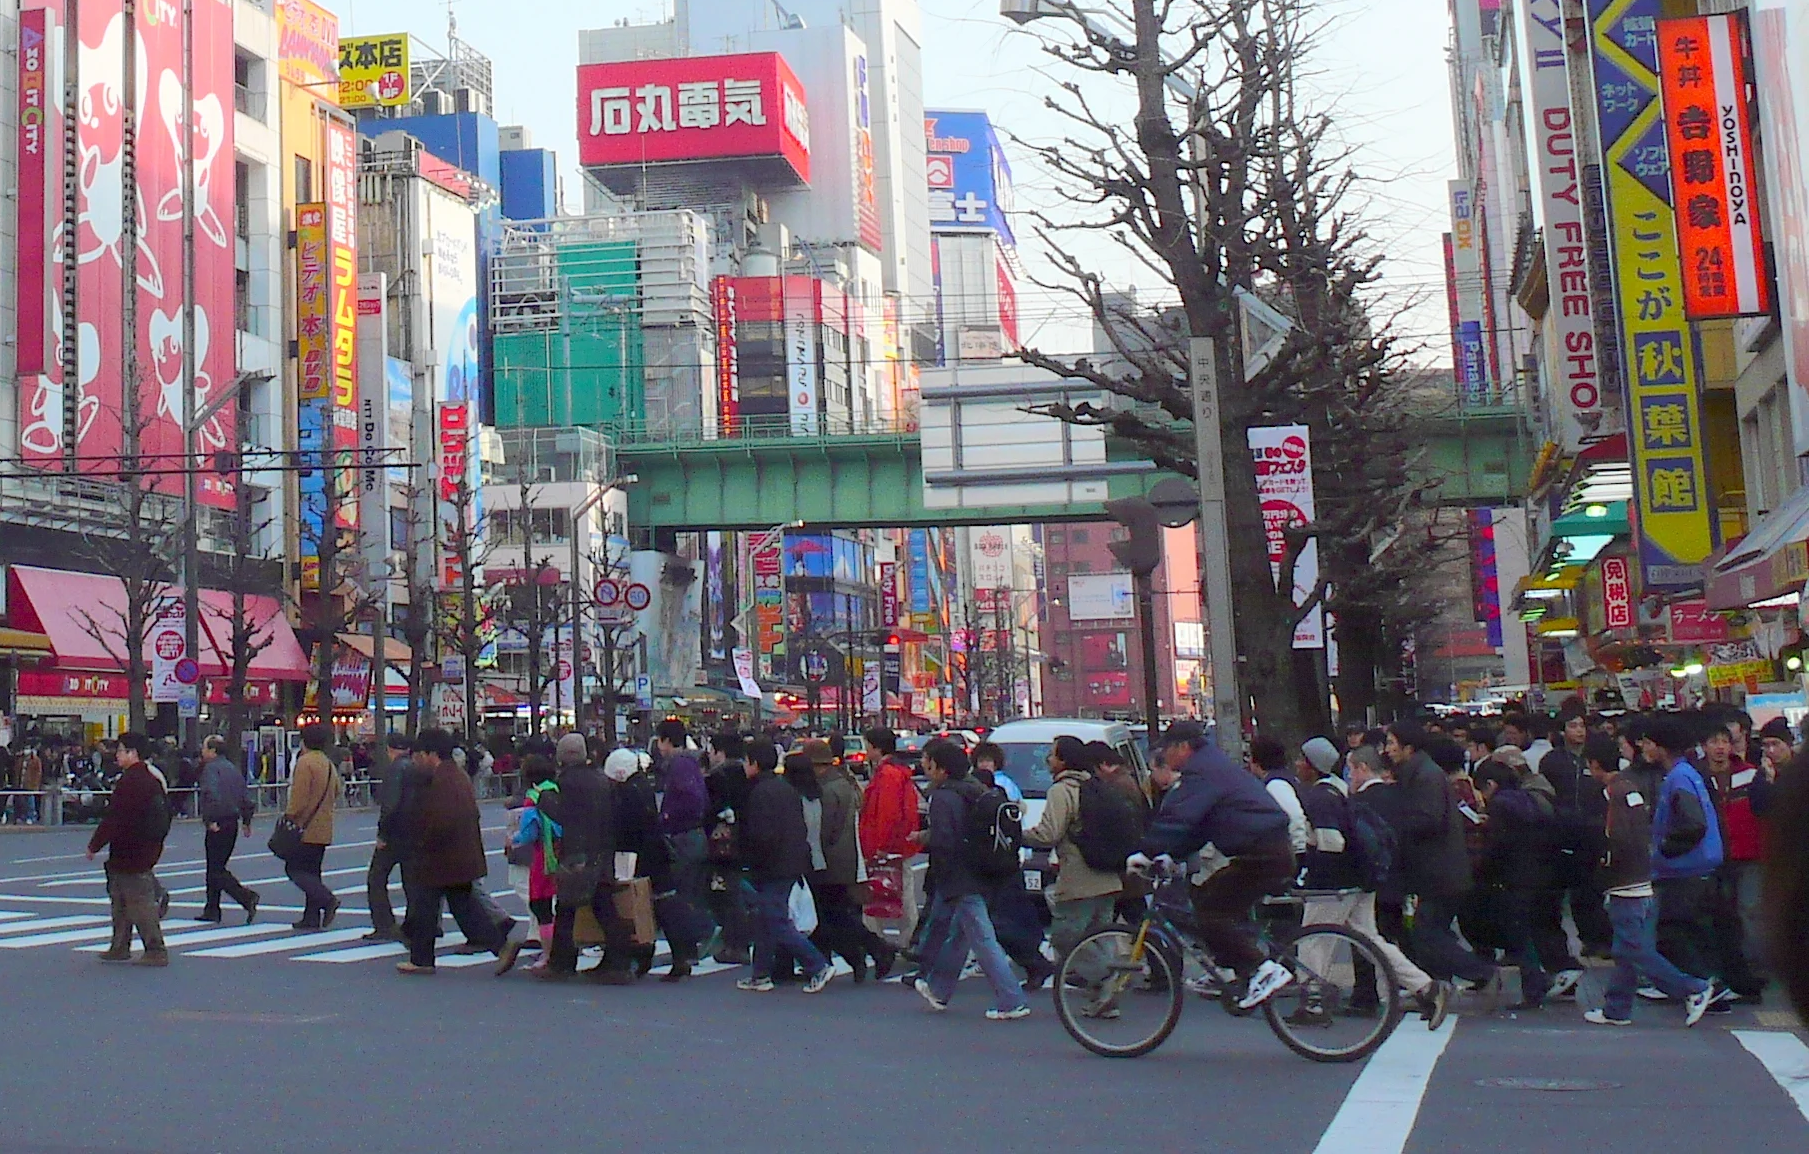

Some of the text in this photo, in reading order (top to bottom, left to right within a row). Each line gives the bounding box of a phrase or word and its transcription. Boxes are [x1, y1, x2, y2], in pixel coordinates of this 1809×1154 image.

[1674, 35, 1703, 89] 牛丼
[589, 76, 768, 137] 石丸電気
[1544, 107, 1580, 207] DUTY
[1676, 104, 1723, 230] 吉野家
[1720, 104, 1748, 227] YOSHINOYA
[1553, 221, 1590, 318] FREE
[1695, 247, 1723, 273] 24
[334, 246, 355, 408] ラムタラ
[1602, 557, 1631, 627] 免税店
[1672, 609, 1722, 626] ラーメン
